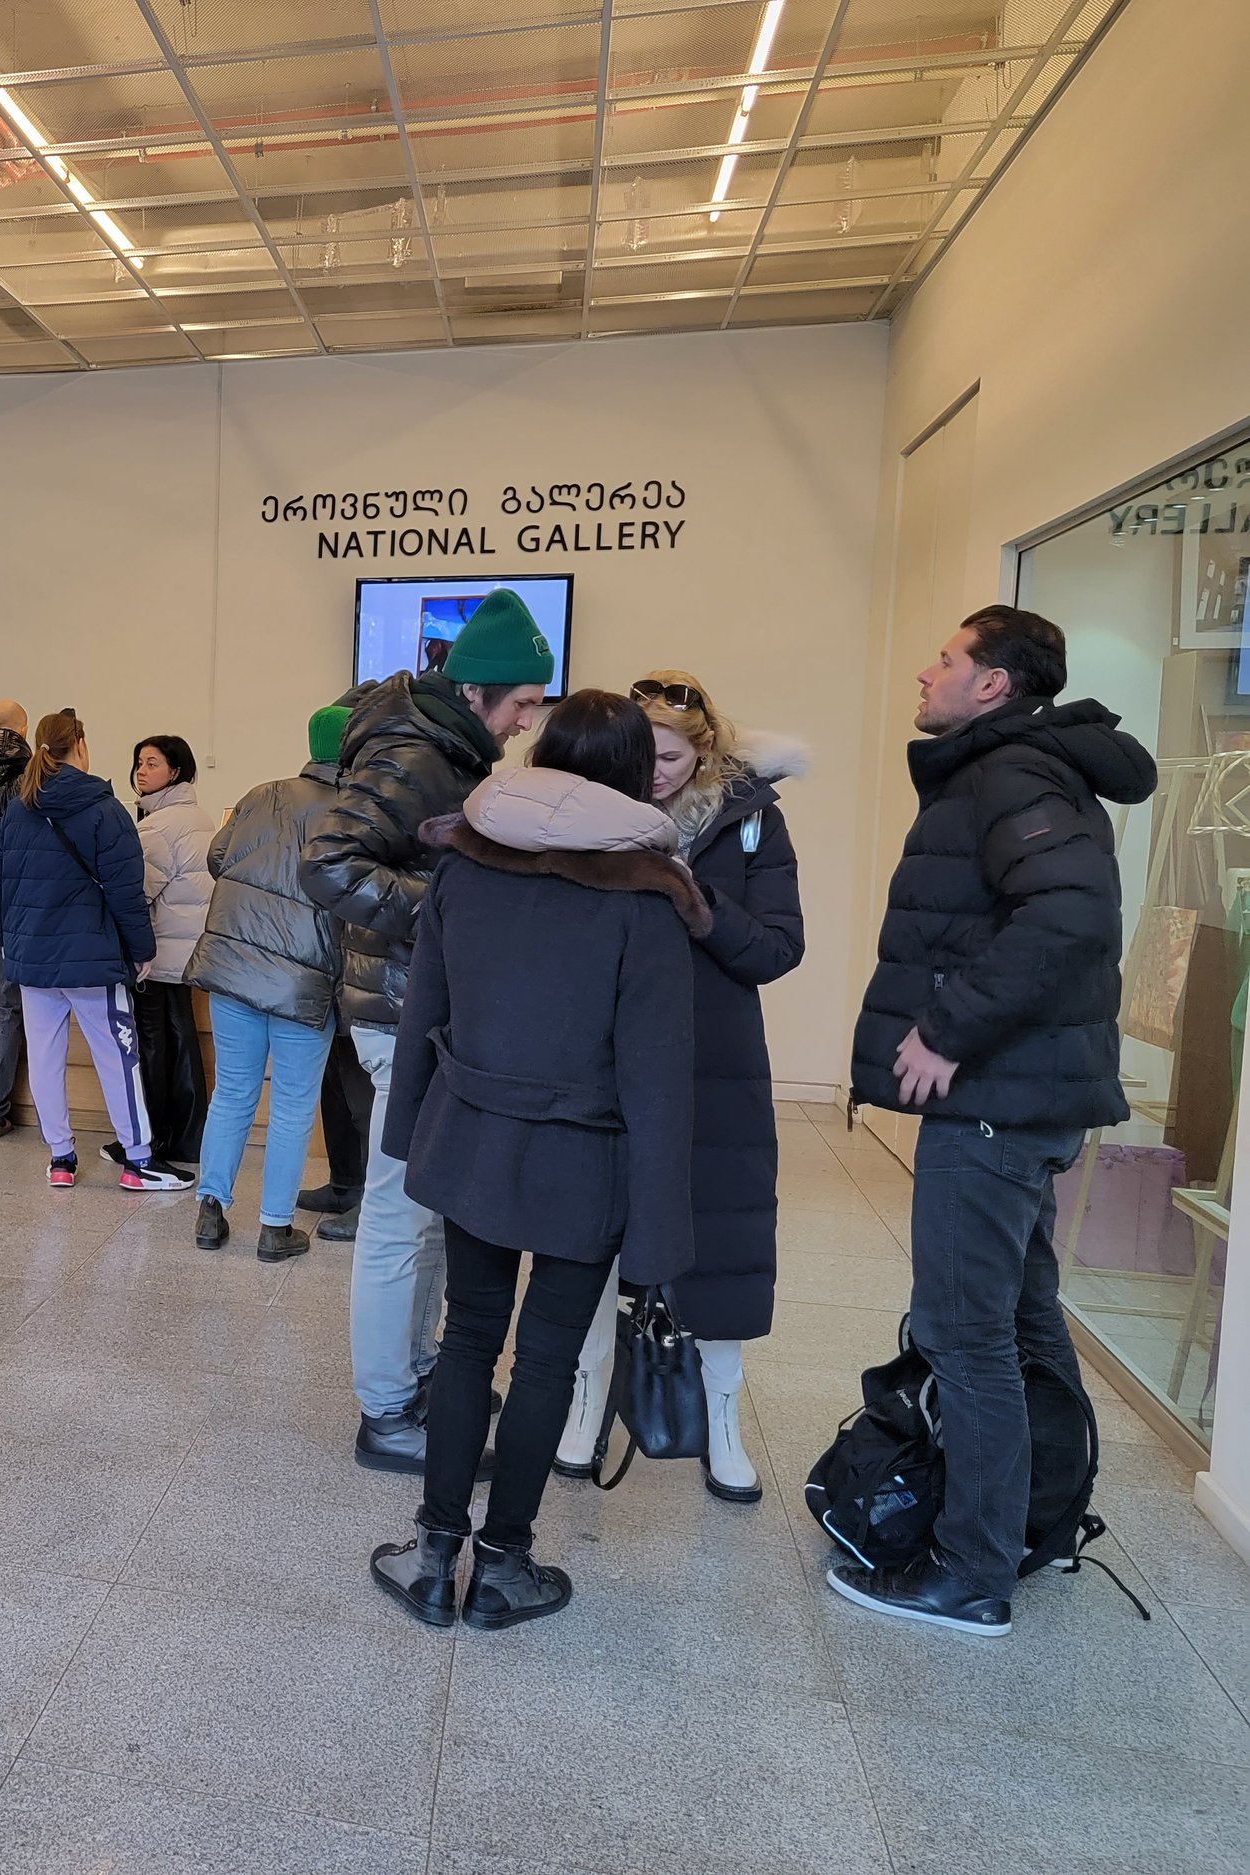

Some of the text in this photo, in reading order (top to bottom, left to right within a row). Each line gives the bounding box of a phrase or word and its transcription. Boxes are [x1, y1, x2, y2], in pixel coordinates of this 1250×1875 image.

[261, 480, 687, 523] ეროვნული გალერეა
[317, 519, 687, 559] NATIONAL GALLERY
